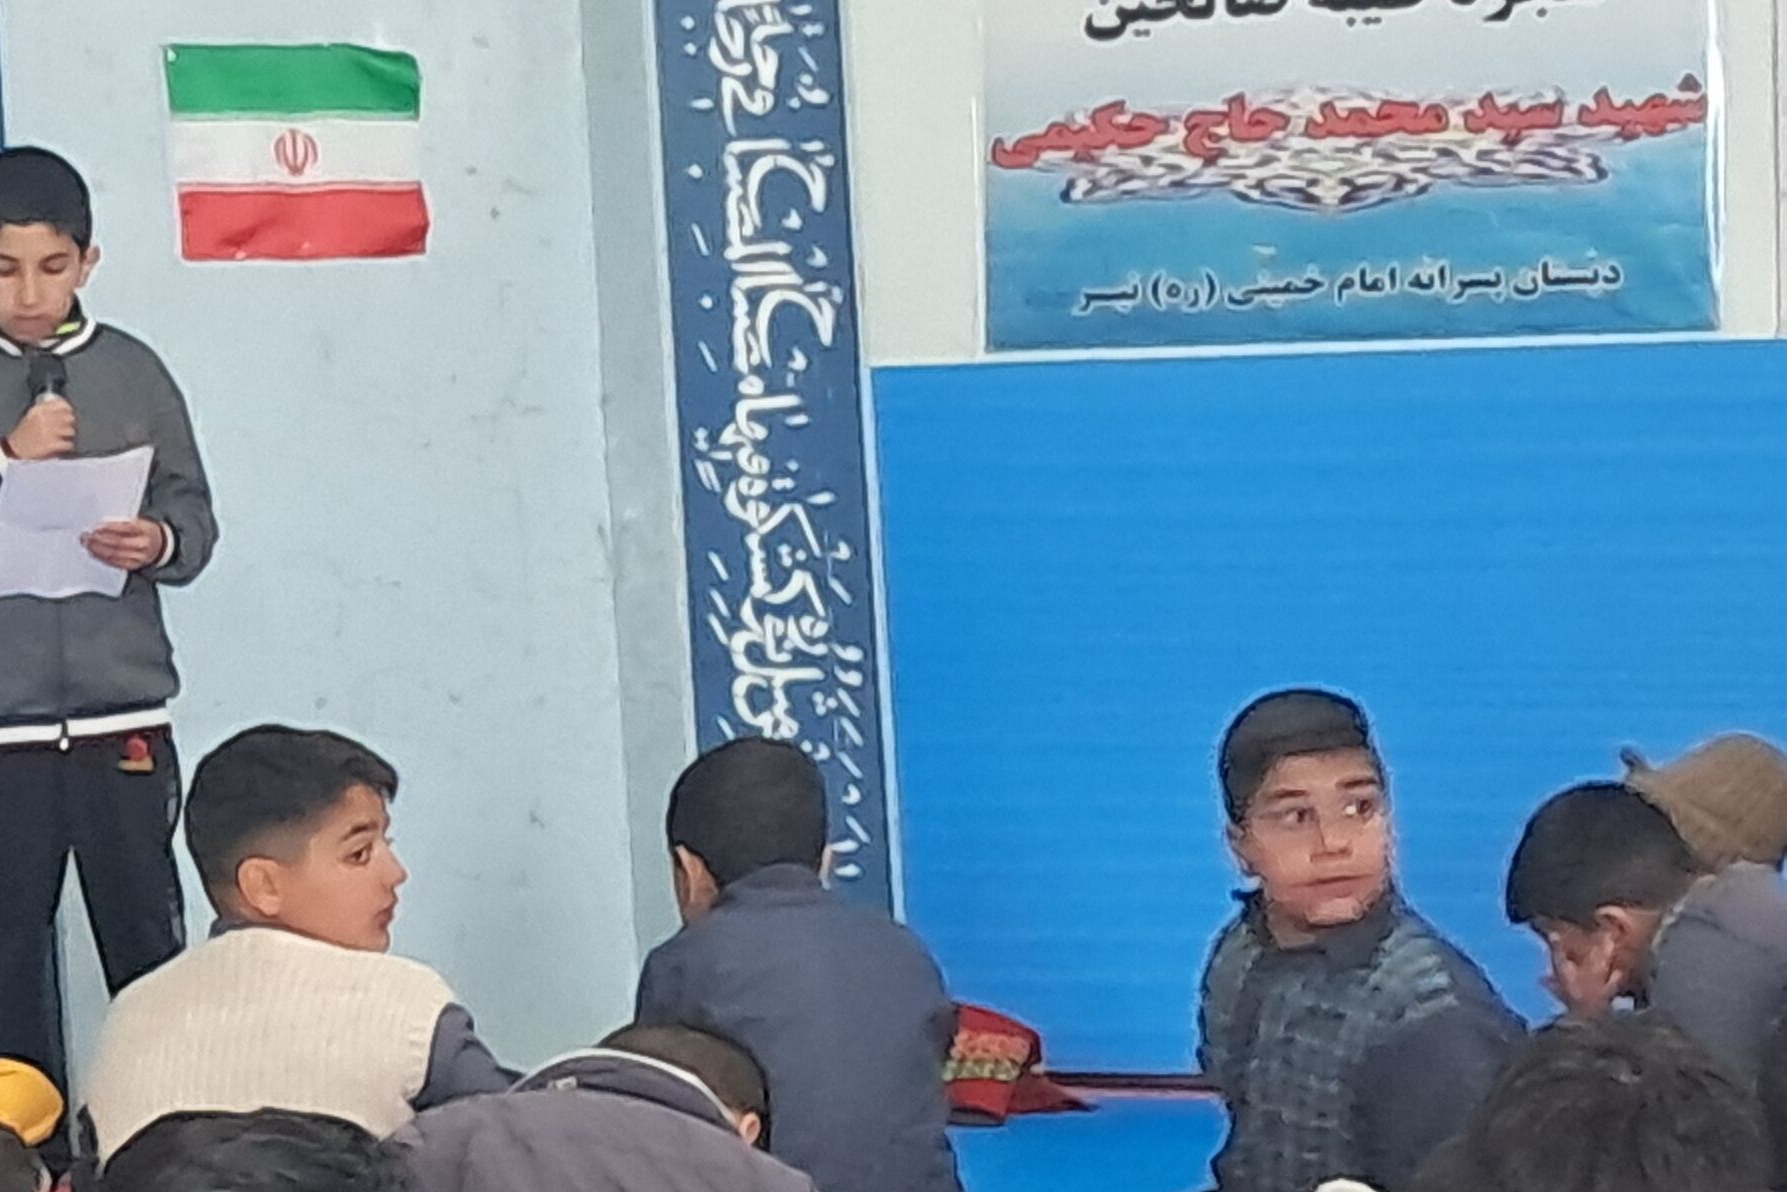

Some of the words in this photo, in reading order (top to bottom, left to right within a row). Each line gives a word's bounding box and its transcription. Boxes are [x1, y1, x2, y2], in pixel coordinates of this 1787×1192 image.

[1184, 92, 1290, 167] حاج
[1305, 100, 1450, 139] محمد
[1464, 91, 1564, 147] سید
[1577, 73, 1708, 142] شهید
[1150, 268, 1218, 311] (ره)
[1226, 266, 1325, 308] خمینی
[1336, 264, 1397, 303] امام
[1512, 249, 1622, 296] دبستان
